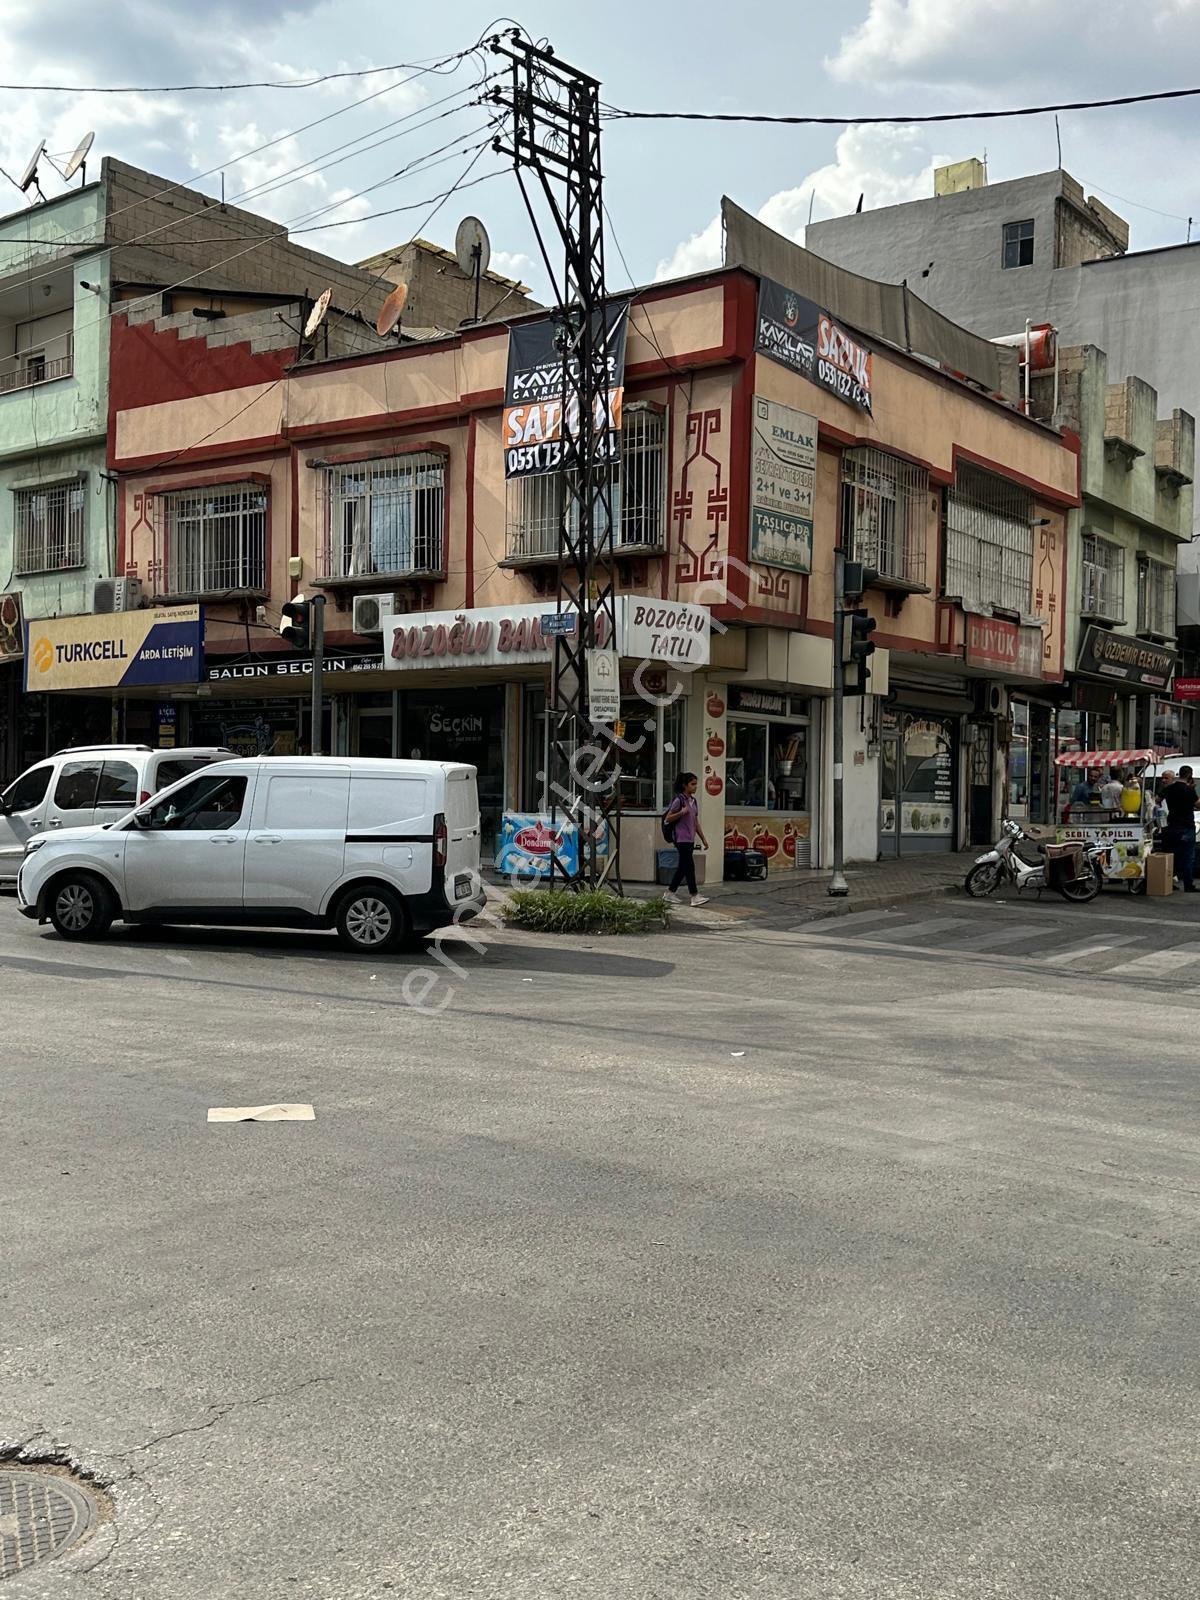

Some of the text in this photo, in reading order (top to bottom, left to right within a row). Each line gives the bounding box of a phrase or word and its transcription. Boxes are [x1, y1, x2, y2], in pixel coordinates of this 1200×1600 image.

[760, 318, 814, 361] KAYALAR
[771, 425, 814, 448] EMLAK
[508, 444, 541, 471] 0531
[756, 477, 811, 505] 2+1 ve 3+1
[634, 606, 705, 633] BOZOĞLU
[391, 614, 492, 659] BOZOĞLU
[650, 634, 693, 657] TATLI
[971, 623, 1016, 657] BÜYÜK
[1103, 635, 1139, 665] ÖZDEMİR
[56, 639, 128, 663] TURKCELL
[139, 646, 194, 661] ARDA İLETİŞİM
[209, 665, 268, 680] SALON
[1064, 829, 1133, 838] SEBİL YAPILIR
